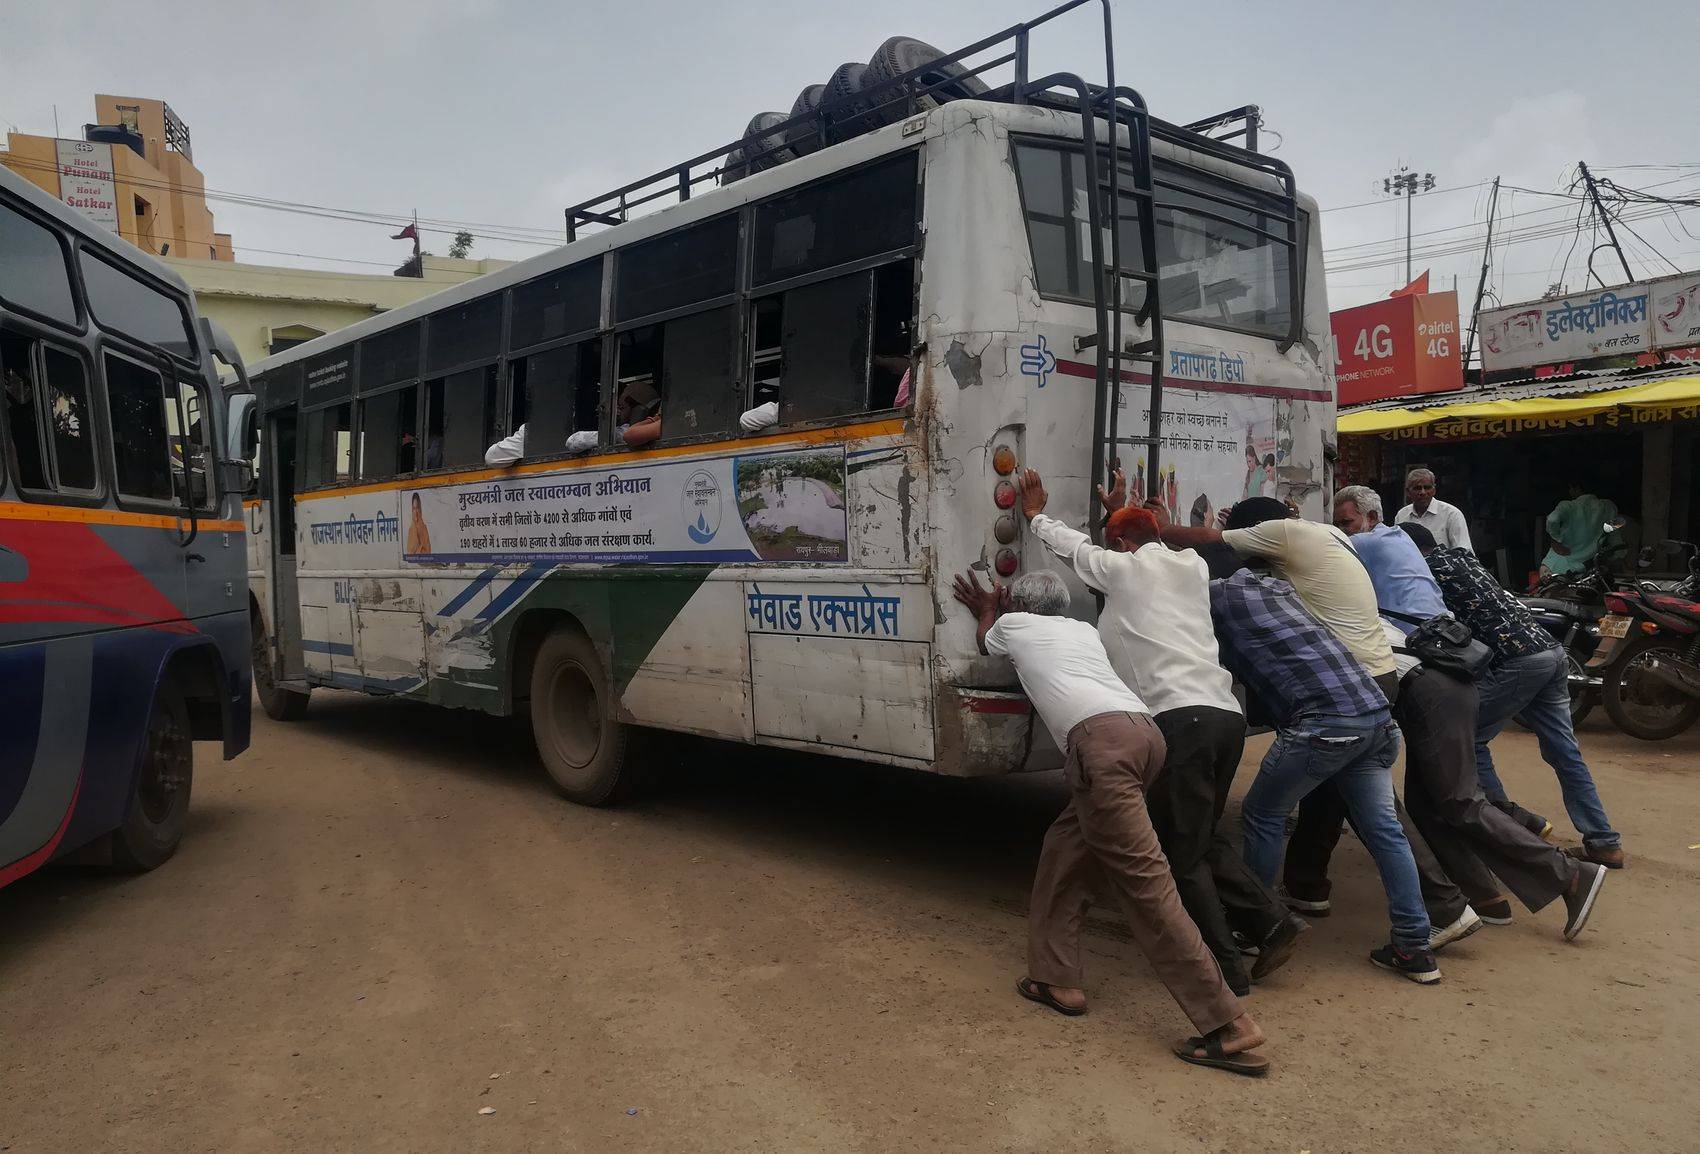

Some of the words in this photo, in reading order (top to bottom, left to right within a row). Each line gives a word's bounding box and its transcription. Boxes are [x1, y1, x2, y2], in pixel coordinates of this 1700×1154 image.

[74, 158, 98, 167] Hotel
[76, 186, 101, 195] Hotel
[66, 196, 113, 209] Satkar
[1428, 320, 1454, 335] airtel
[1353, 324, 1393, 361] 4G
[1426, 337, 1449, 358] 4G
[1360, 366, 1396, 379] NETWORK
[458, 485, 501, 511] मुख्यमंत्री
[504, 488, 525, 502] जल
[528, 482, 591, 501] स्वावलम्बन
[595, 474, 652, 497] अभियान
[310, 521, 343, 545] राजस्थान
[344, 513, 375, 545] परिवहन
[376, 510, 399, 543] निगम
[459, 514, 474, 531] तृतीय
[476, 516, 490, 527] चरण
[499, 512, 513, 526] सभी
[514, 511, 532, 526] जिलों
[533, 510, 541, 525] के
[543, 512, 560, 524] 4200
[562, 509, 569, 523] से
[571, 508, 596, 523] अधिक
[598, 505, 618, 522] गांवों
[619, 505, 632, 523] एवं
[472, 534, 488, 549] शहरों
[496, 538, 500, 548] 1
[501, 537, 518, 548] लाख
[519, 536, 528, 548] 60
[529, 536, 548, 549] हजार
[549, 532, 557, 547] से
[558, 532, 583, 547] अधिक
[584, 535, 599, 547] जल
[601, 531, 630, 547] संरक्षण
[807, 583, 901, 636] एक्सप्रेस
